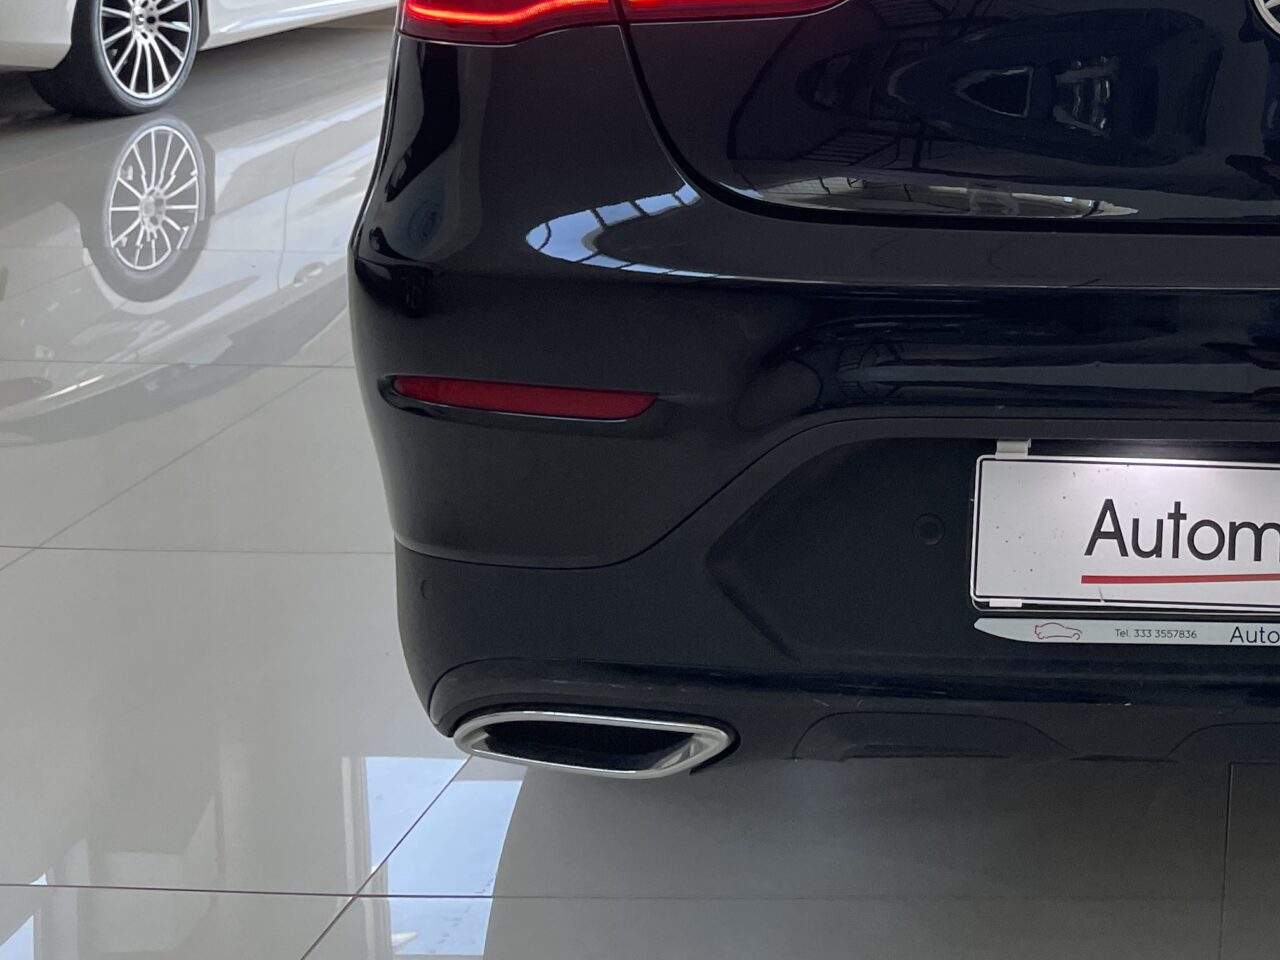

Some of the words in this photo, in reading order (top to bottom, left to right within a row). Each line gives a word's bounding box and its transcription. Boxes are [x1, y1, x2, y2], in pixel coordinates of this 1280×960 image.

[1115, 628, 1132, 638] Tel.
[1134, 628, 1152, 638] 333
[1155, 629, 1197, 639] 3557836
